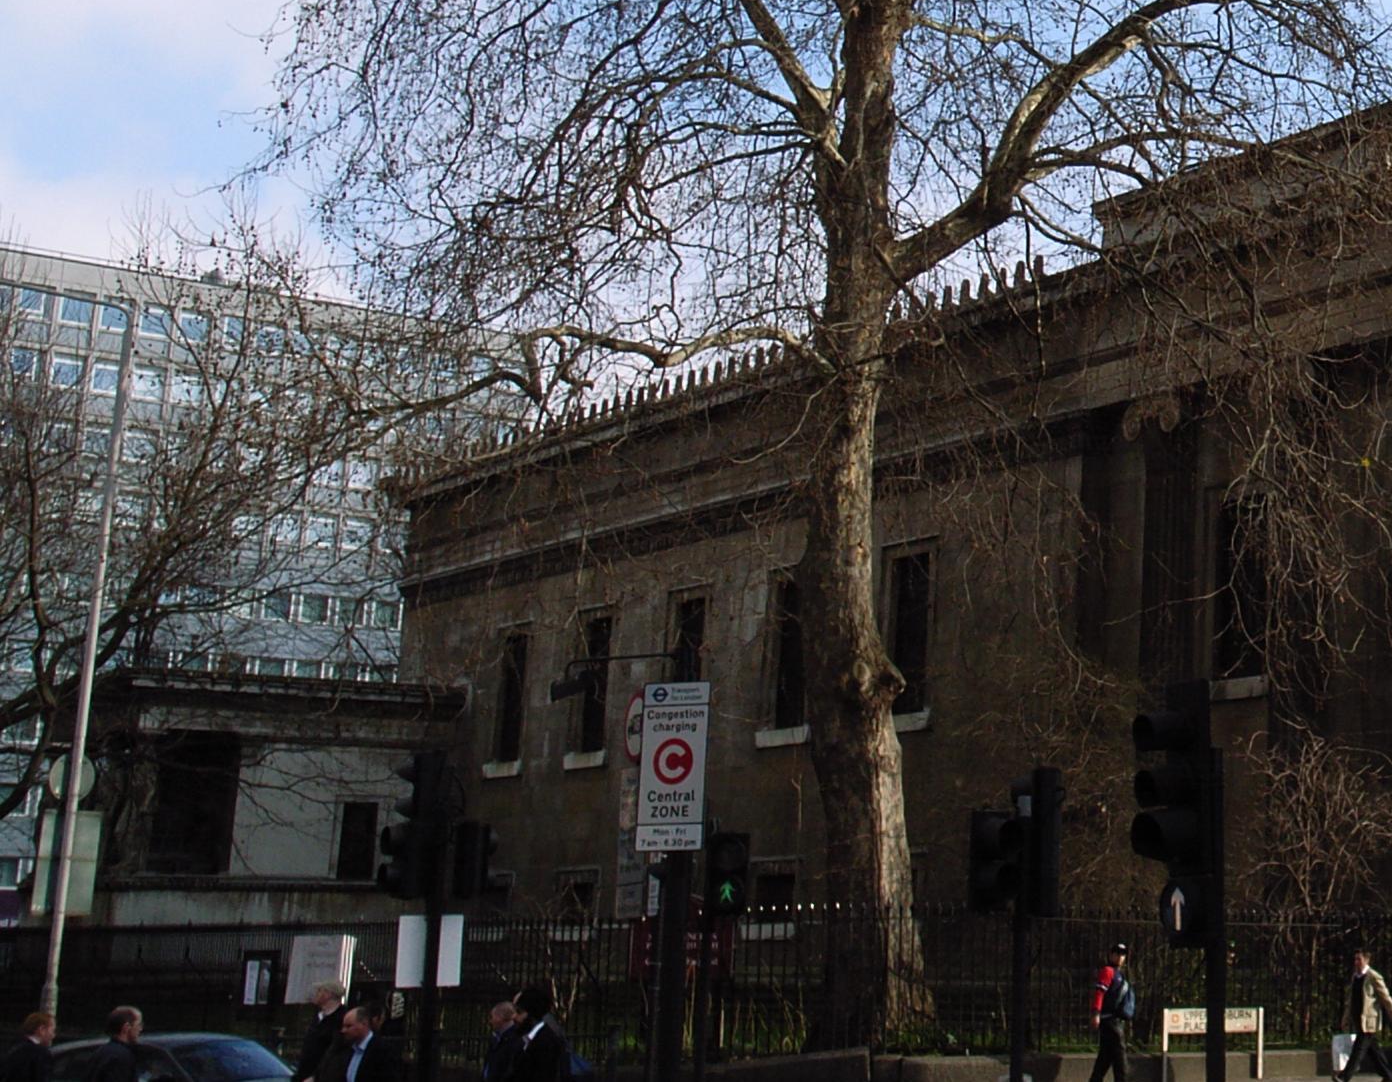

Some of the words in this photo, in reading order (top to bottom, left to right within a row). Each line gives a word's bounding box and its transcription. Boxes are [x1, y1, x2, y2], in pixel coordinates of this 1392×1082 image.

[647, 709, 705, 721] Congestion
[653, 722, 697, 733] charging
[647, 790, 695, 802] Central
[651, 805, 689, 818] ZONE
